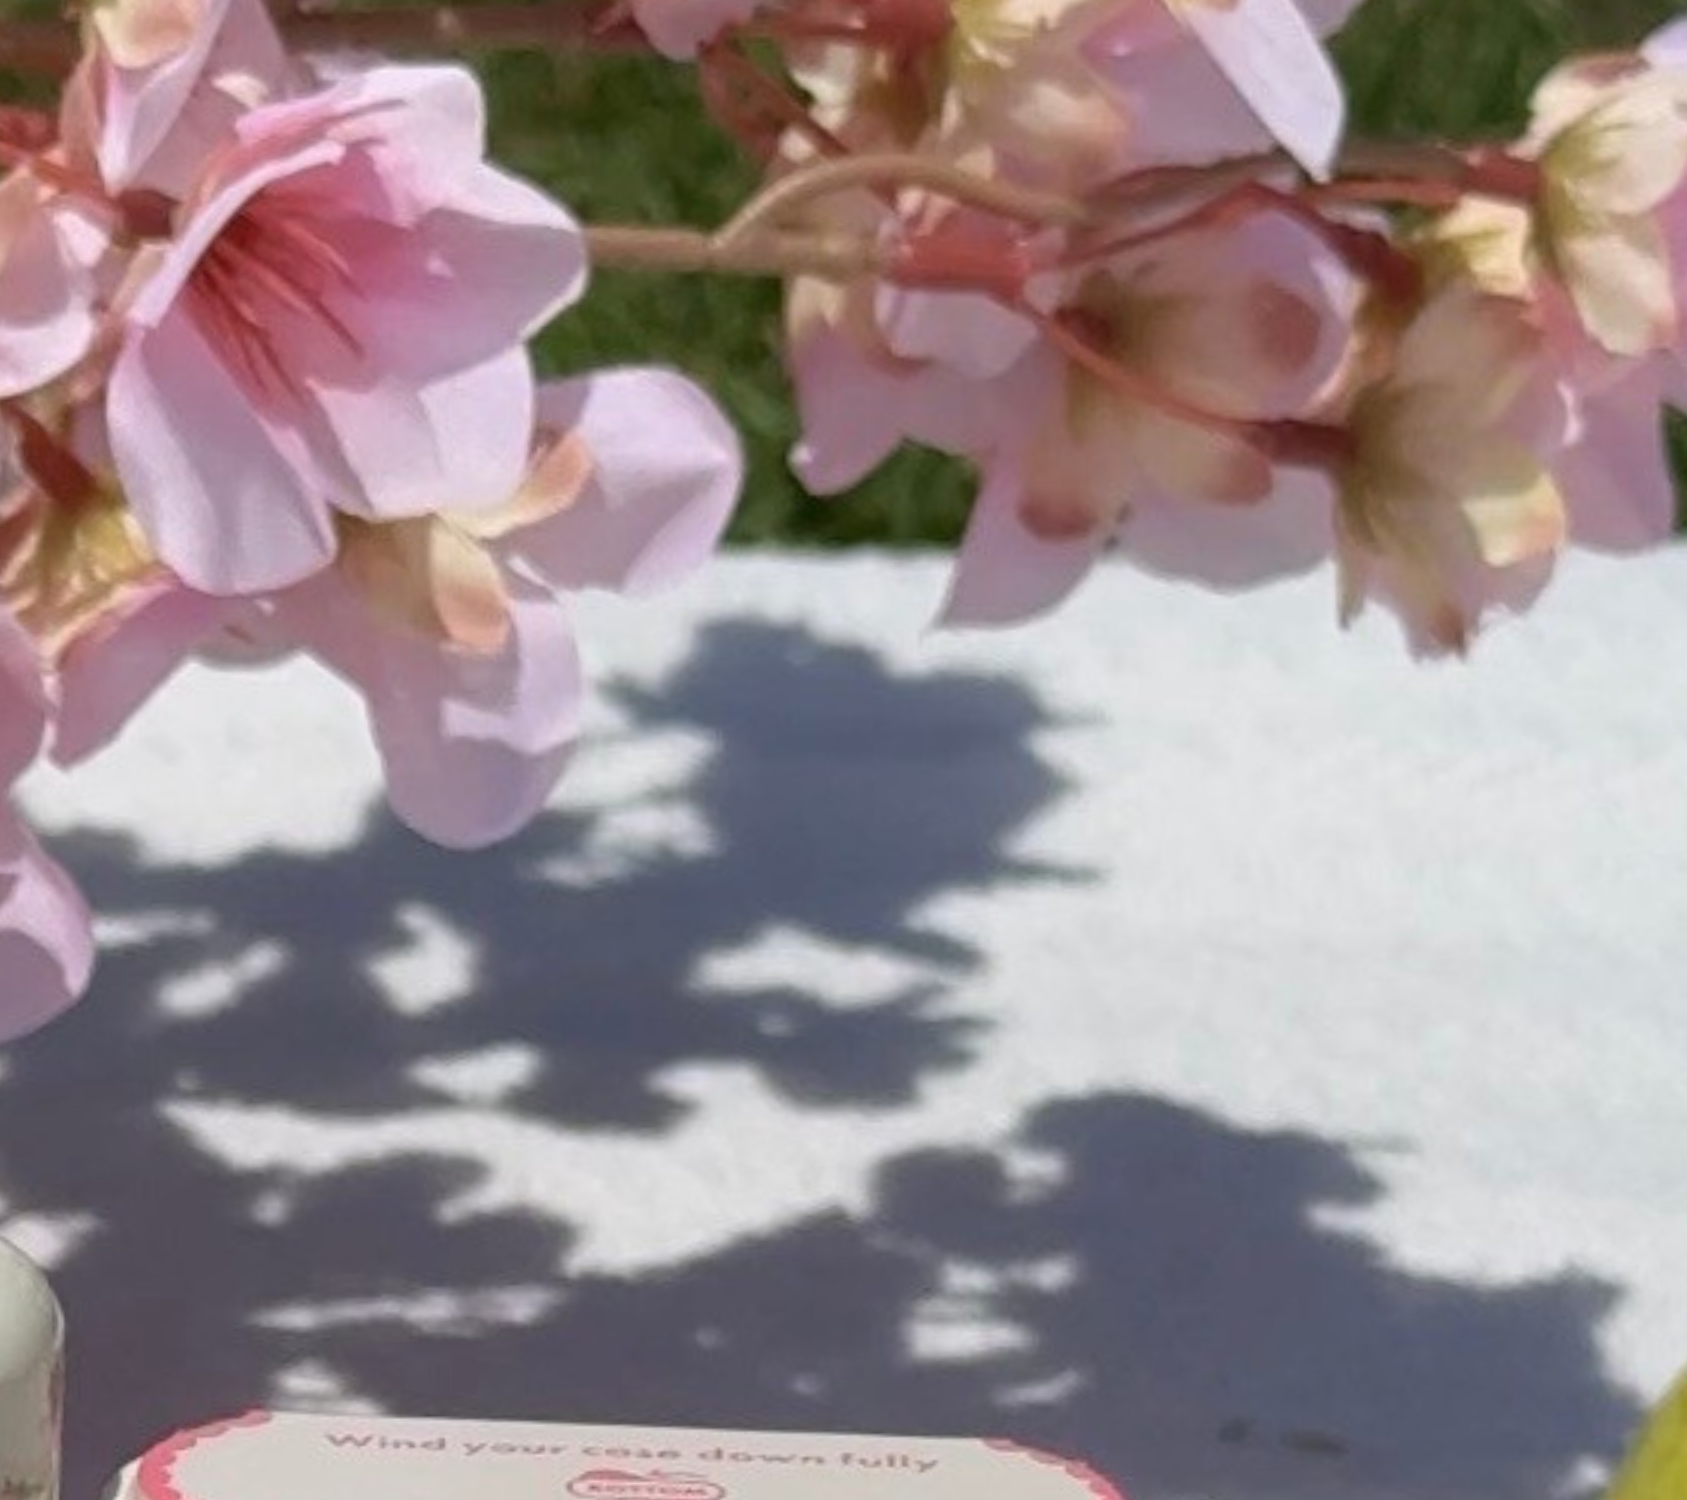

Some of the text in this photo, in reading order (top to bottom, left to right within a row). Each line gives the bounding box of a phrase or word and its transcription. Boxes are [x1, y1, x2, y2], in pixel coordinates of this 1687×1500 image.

[325, 1434, 938, 1473] Wind your case down fully
